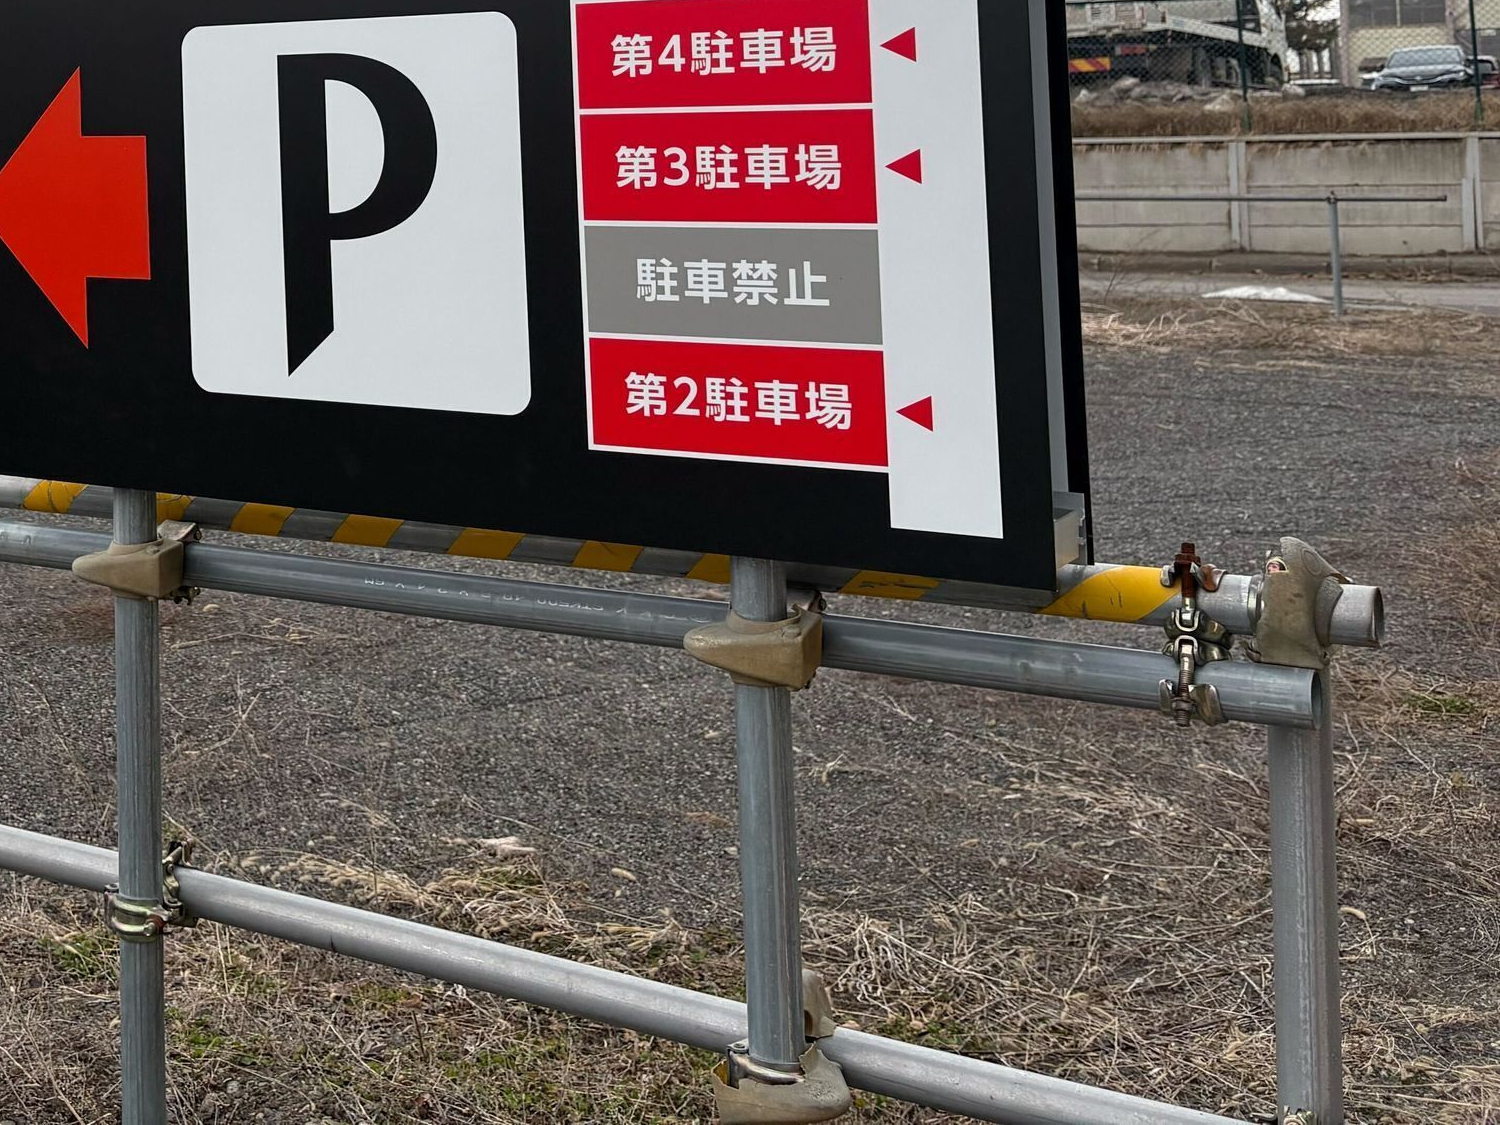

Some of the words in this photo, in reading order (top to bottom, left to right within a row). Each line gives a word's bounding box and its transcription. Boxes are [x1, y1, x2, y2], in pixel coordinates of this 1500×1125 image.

[610, 26, 837, 78] 第4駐車場
[614, 143, 842, 190] 第3駐車場
[276, 52, 438, 377] P
[636, 256, 830, 306] 駐車禁止
[624, 371, 852, 430] 第2駐車場
